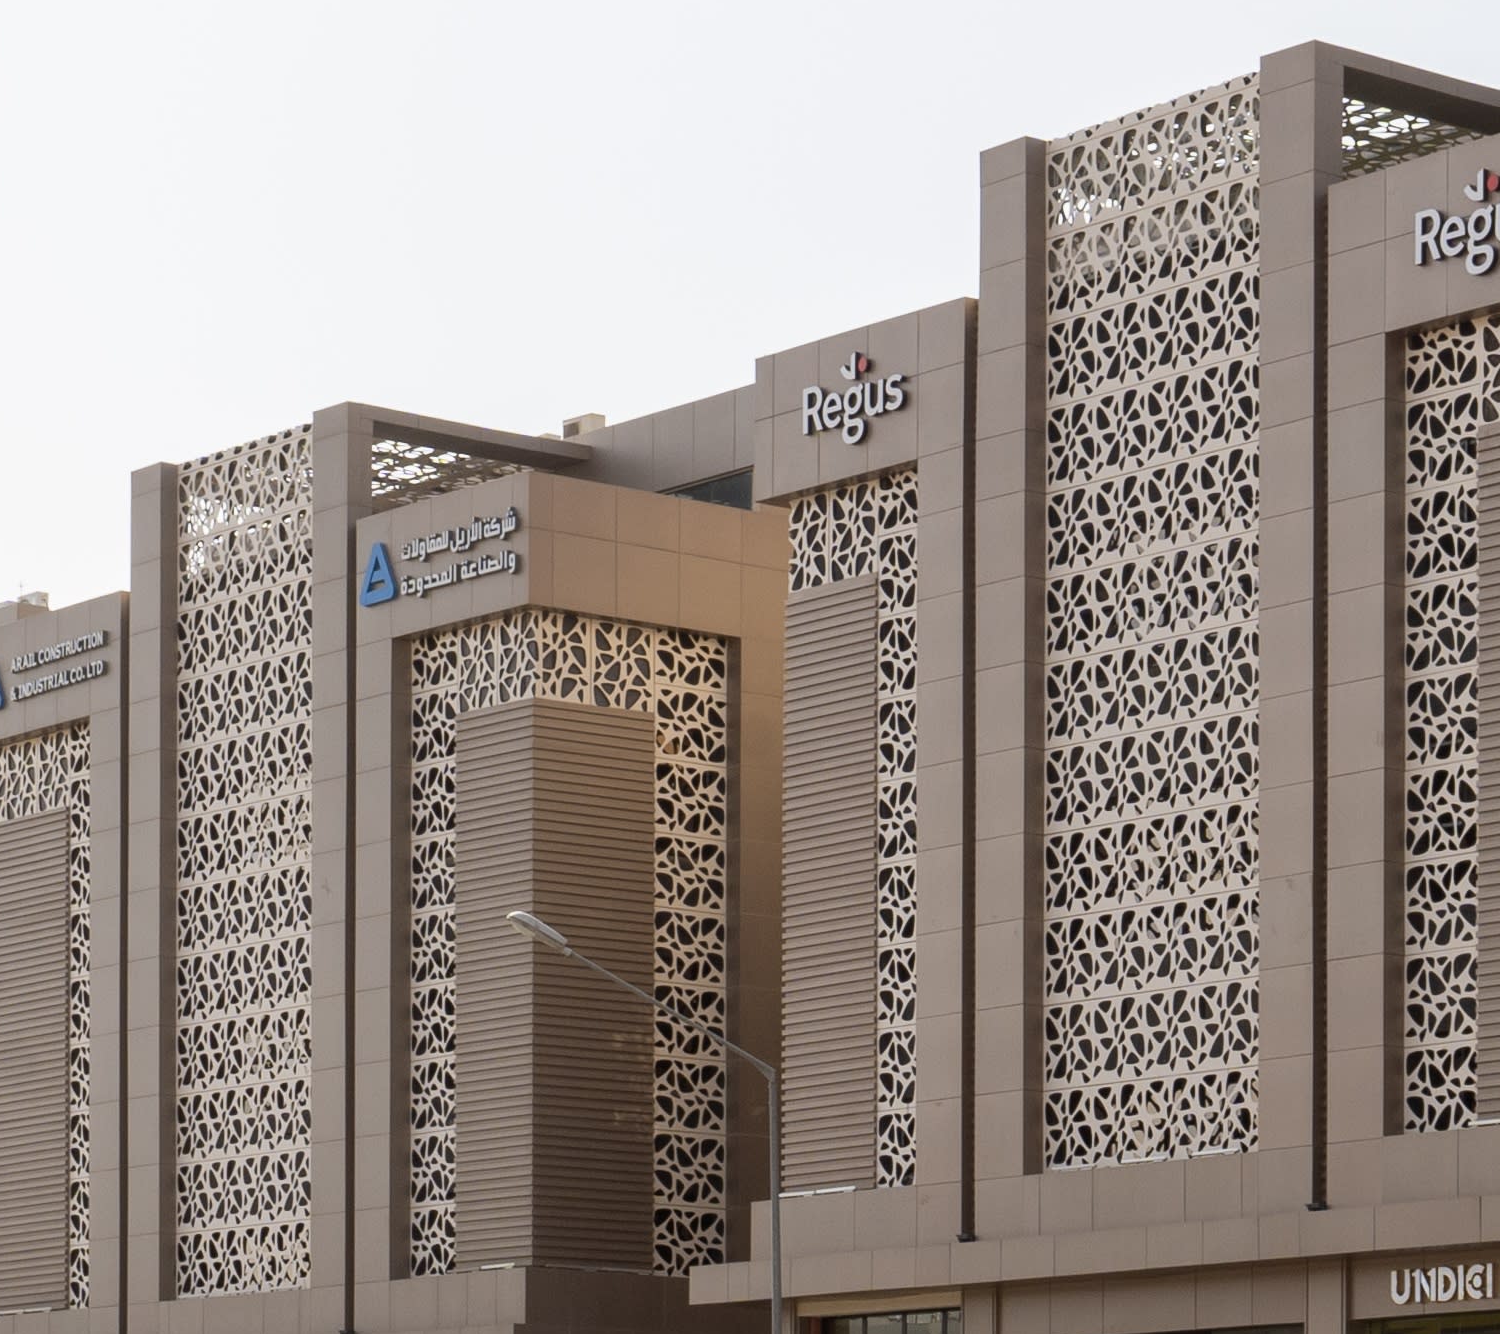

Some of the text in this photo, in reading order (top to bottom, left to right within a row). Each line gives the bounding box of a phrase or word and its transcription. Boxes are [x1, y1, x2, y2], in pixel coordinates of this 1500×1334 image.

[802, 373, 905, 445] Regus
[483, 507, 516, 539] شركة
[401, 531, 449, 562] للمقاولات
[401, 551, 516, 597] والصناعة المحدودة
[37, 630, 105, 664] CONSTRUCTION
[10, 660, 105, 701] & INDUSTRIAL CO. LTD
